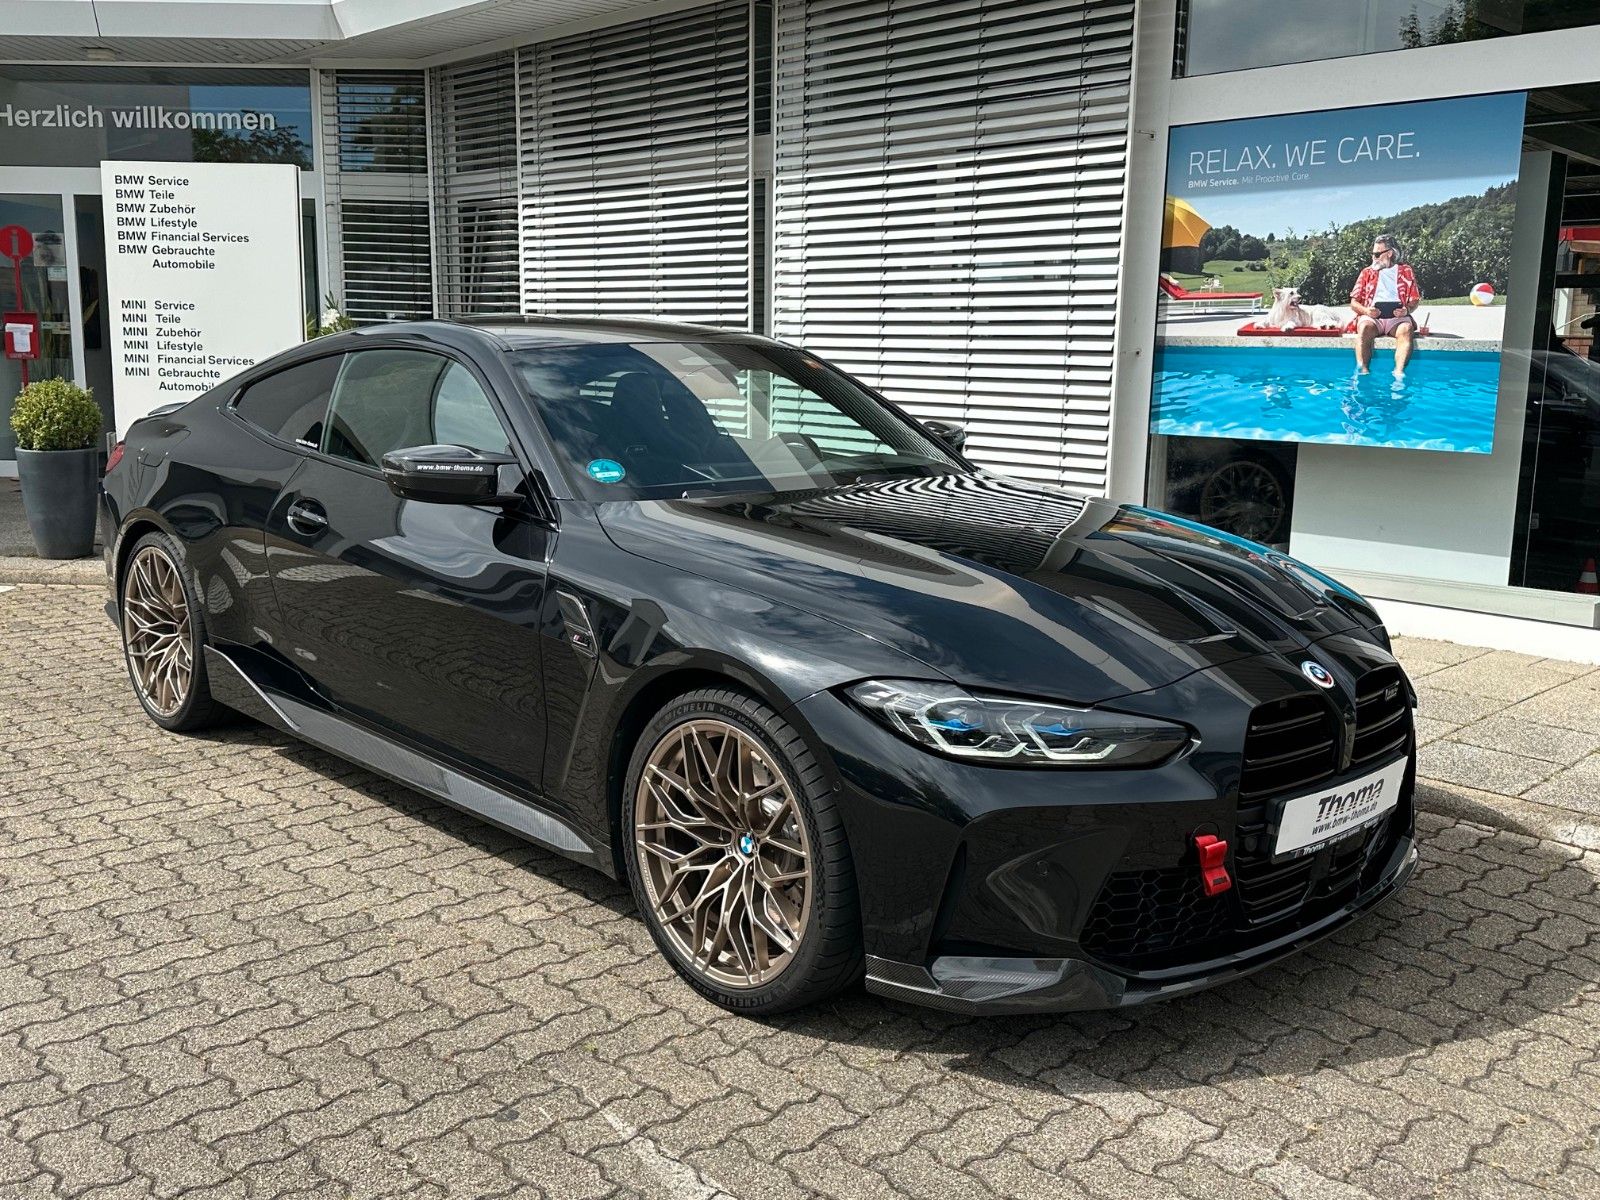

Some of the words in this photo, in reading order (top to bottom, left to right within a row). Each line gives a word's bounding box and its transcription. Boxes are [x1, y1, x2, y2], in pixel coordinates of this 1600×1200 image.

[0, 104, 103, 128] Herzlich
[112, 105, 275, 131] willkommen
[1189, 144, 1277, 175] RELAX.
[1286, 139, 1327, 168] WE
[1337, 131, 1420, 164] CARE.
[114, 175, 144, 185] BMW
[148, 175, 190, 186] Service
[1188, 180, 1207, 189] BMW
[1209, 178, 1239, 188] Service.
[1255, 173, 1290, 184] Proactive
[115, 189, 145, 199] BMW
[149, 189, 175, 200] Teile
[116, 203, 145, 213] BMW
[149, 203, 196, 214] Zubehör
[117, 217, 146, 227] BMW
[150, 217, 198, 230] Lifestyle
[117, 230, 147, 241] BMW
[151, 231, 200, 242] Financial
[202, 232, 250, 243] Services
[118, 244, 147, 254] BMW
[152, 244, 216, 256] Gebrauchte
[152, 259, 216, 269] Automobile
[121, 300, 147, 310] MINI
[154, 300, 195, 311] Service
[122, 313, 147, 323] MINI
[155, 314, 181, 324] Teile
[123, 327, 148, 337] MINI
[156, 327, 202, 338] Zubehör
[123, 340, 149, 350] MINI
[157, 340, 203, 353] Lifestyle
[124, 353, 149, 363] MINI
[157, 354, 206, 365] Financial
[208, 355, 255, 366] Services
[125, 367, 150, 377] MINI
[157, 367, 221, 379] Gebrauchte
[417, 464, 484, 472] www.bmw-thoma.de
[1316, 778, 1385, 822] Thoma
